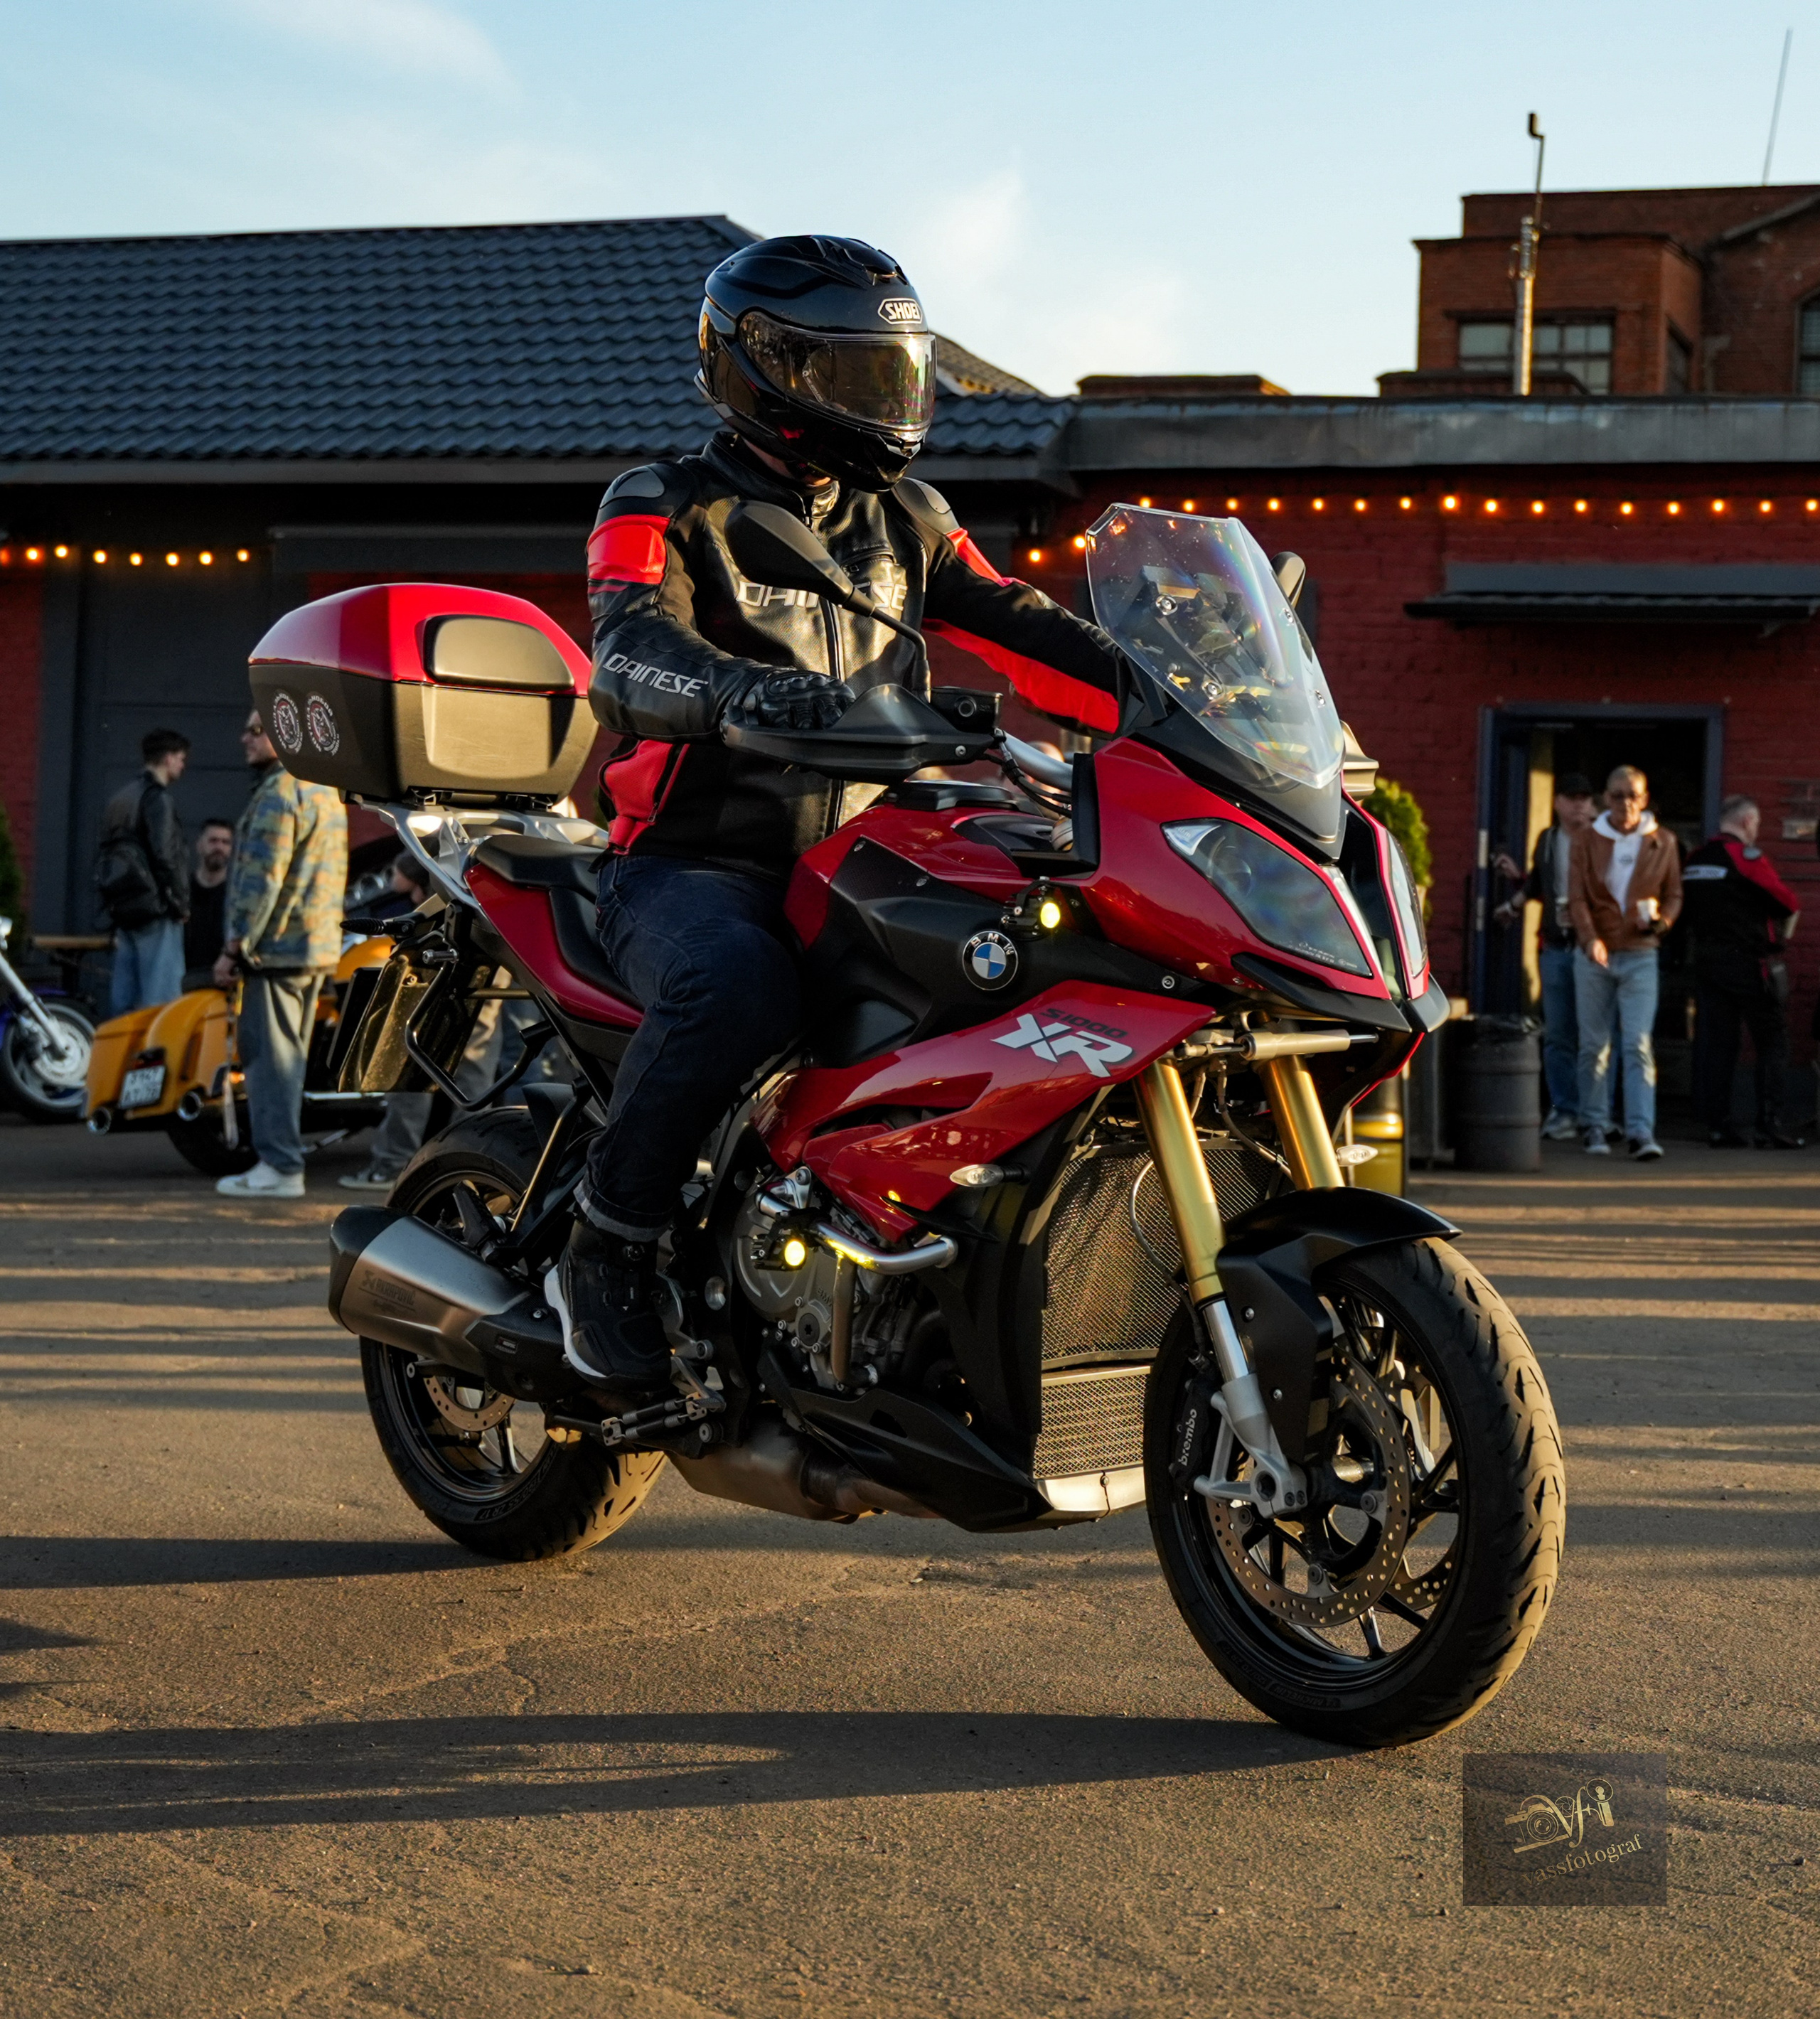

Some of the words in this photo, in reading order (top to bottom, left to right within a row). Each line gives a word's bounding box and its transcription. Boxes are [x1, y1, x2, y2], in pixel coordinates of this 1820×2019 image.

[884, 302, 921, 320] SHOEI
[736, 581, 908, 611] DAISE
[603, 653, 709, 697] DAINESE
[970, 933, 1015, 955] BMW
[990, 1013, 1133, 1078] XR
[1178, 1408, 1197, 1466] brembo
